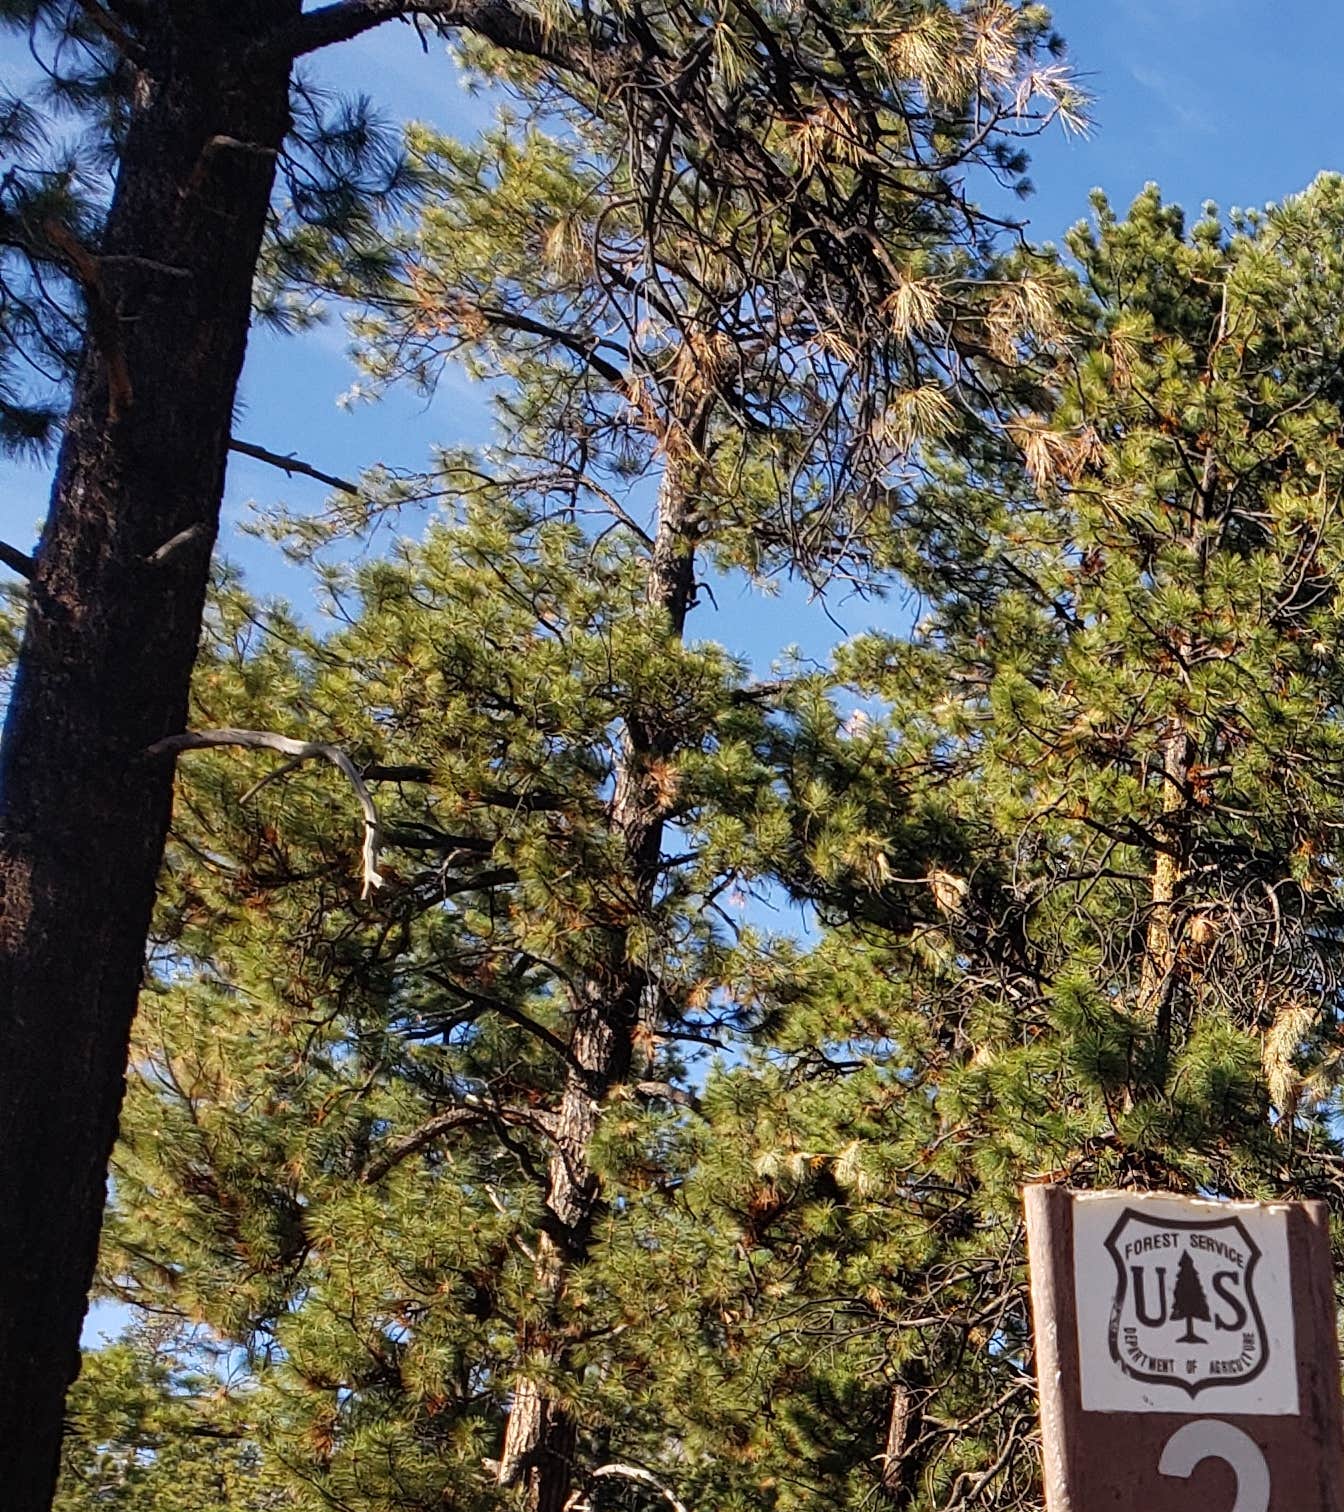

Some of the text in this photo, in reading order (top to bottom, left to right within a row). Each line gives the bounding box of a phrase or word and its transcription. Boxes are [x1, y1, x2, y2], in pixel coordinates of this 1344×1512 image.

[1124, 1233, 1244, 1269] FOREST SERVICE
[1122, 1327, 1176, 1374] DEPARTMENT
[1186, 1360, 1199, 1374] OF
